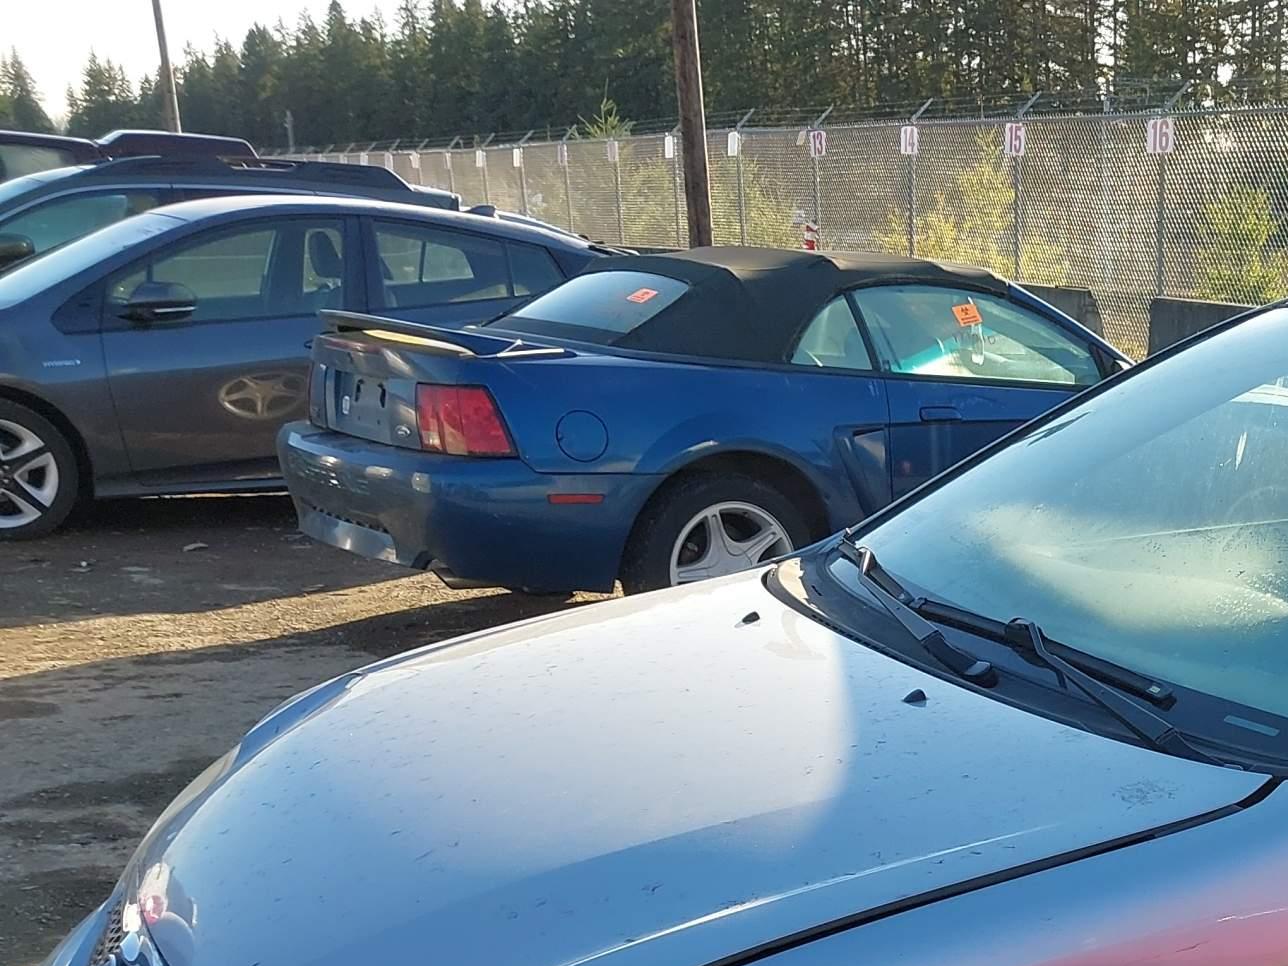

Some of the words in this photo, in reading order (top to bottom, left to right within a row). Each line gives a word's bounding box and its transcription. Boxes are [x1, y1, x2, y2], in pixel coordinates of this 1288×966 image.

[812, 132, 823, 156] 13
[903, 127, 915, 154] 14
[1008, 123, 1022, 154] 15
[1151, 119, 1170, 151] 16
